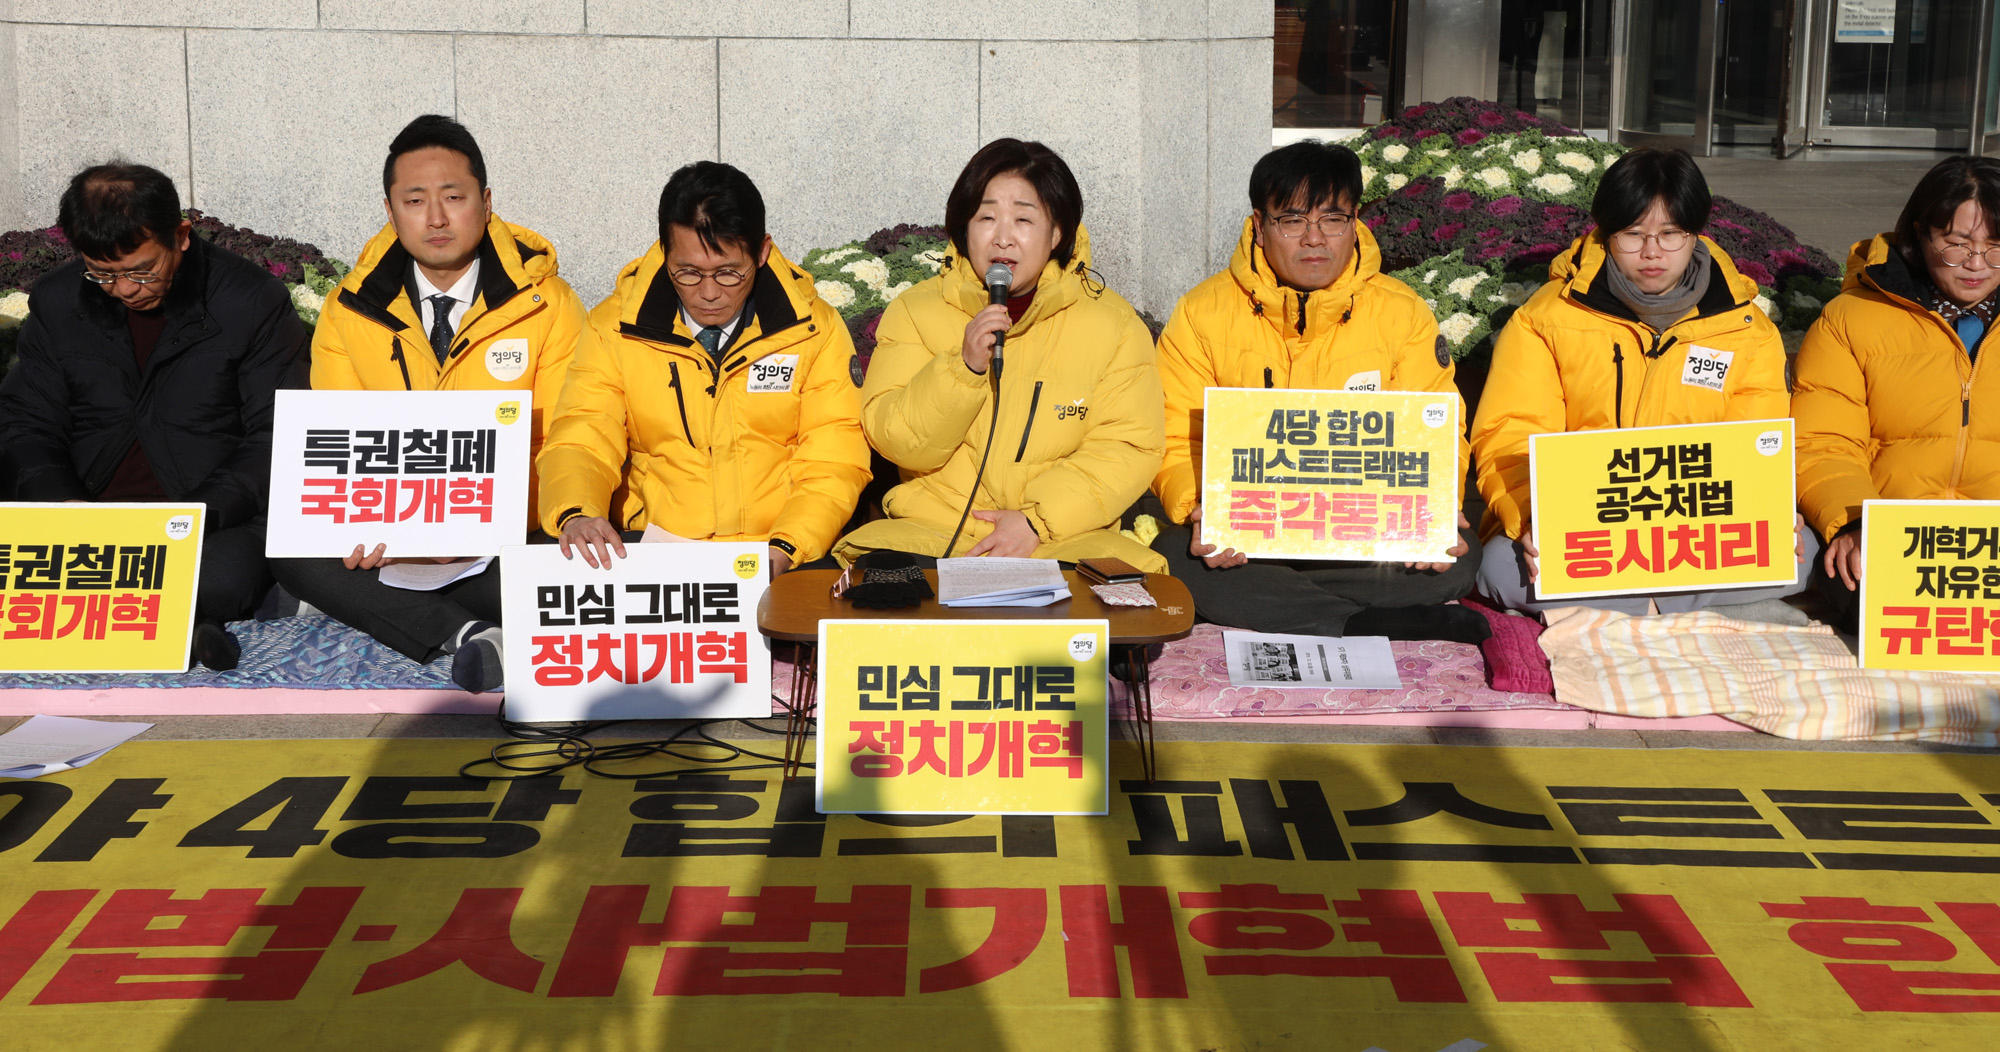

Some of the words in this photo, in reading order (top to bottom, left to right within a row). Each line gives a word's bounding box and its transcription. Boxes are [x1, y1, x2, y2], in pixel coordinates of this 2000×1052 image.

[491, 351, 523, 364] 정의당
[752, 364, 794, 382] 정의당
[1688, 356, 1728, 380] 정의당
[1053, 404, 1089, 420] 정의당
[1266, 409, 1320, 446] 4당
[1327, 409, 1394, 447] 합의
[304, 429, 496, 474] 특권철폐
[1231, 447, 1429, 487] 패스트트랙법
[1606, 442, 1712, 484] 선거법
[302, 477, 493, 523] 국회개혁
[1229, 489, 1433, 542] 즉각통과
[1596, 480, 1734, 524] 공수처법
[0, 544, 167, 590] 권철폐
[1564, 520, 1770, 579] 동시처리
[0, 593, 160, 640] 회개혁
[538, 584, 614, 626] 민심
[626, 583, 739, 623] 그대로
[1073, 640, 1093, 649] 정의당
[1881, 606, 2000, 656] 규탄
[532, 631, 747, 686] 정치개혁
[858, 666, 940, 710] 민심
[951, 665, 1075, 711] 그대로
[849, 720, 1083, 779] 정치개혁
[177, 775, 580, 859] 4당
[1119, 778, 2000, 874] 패스트트
